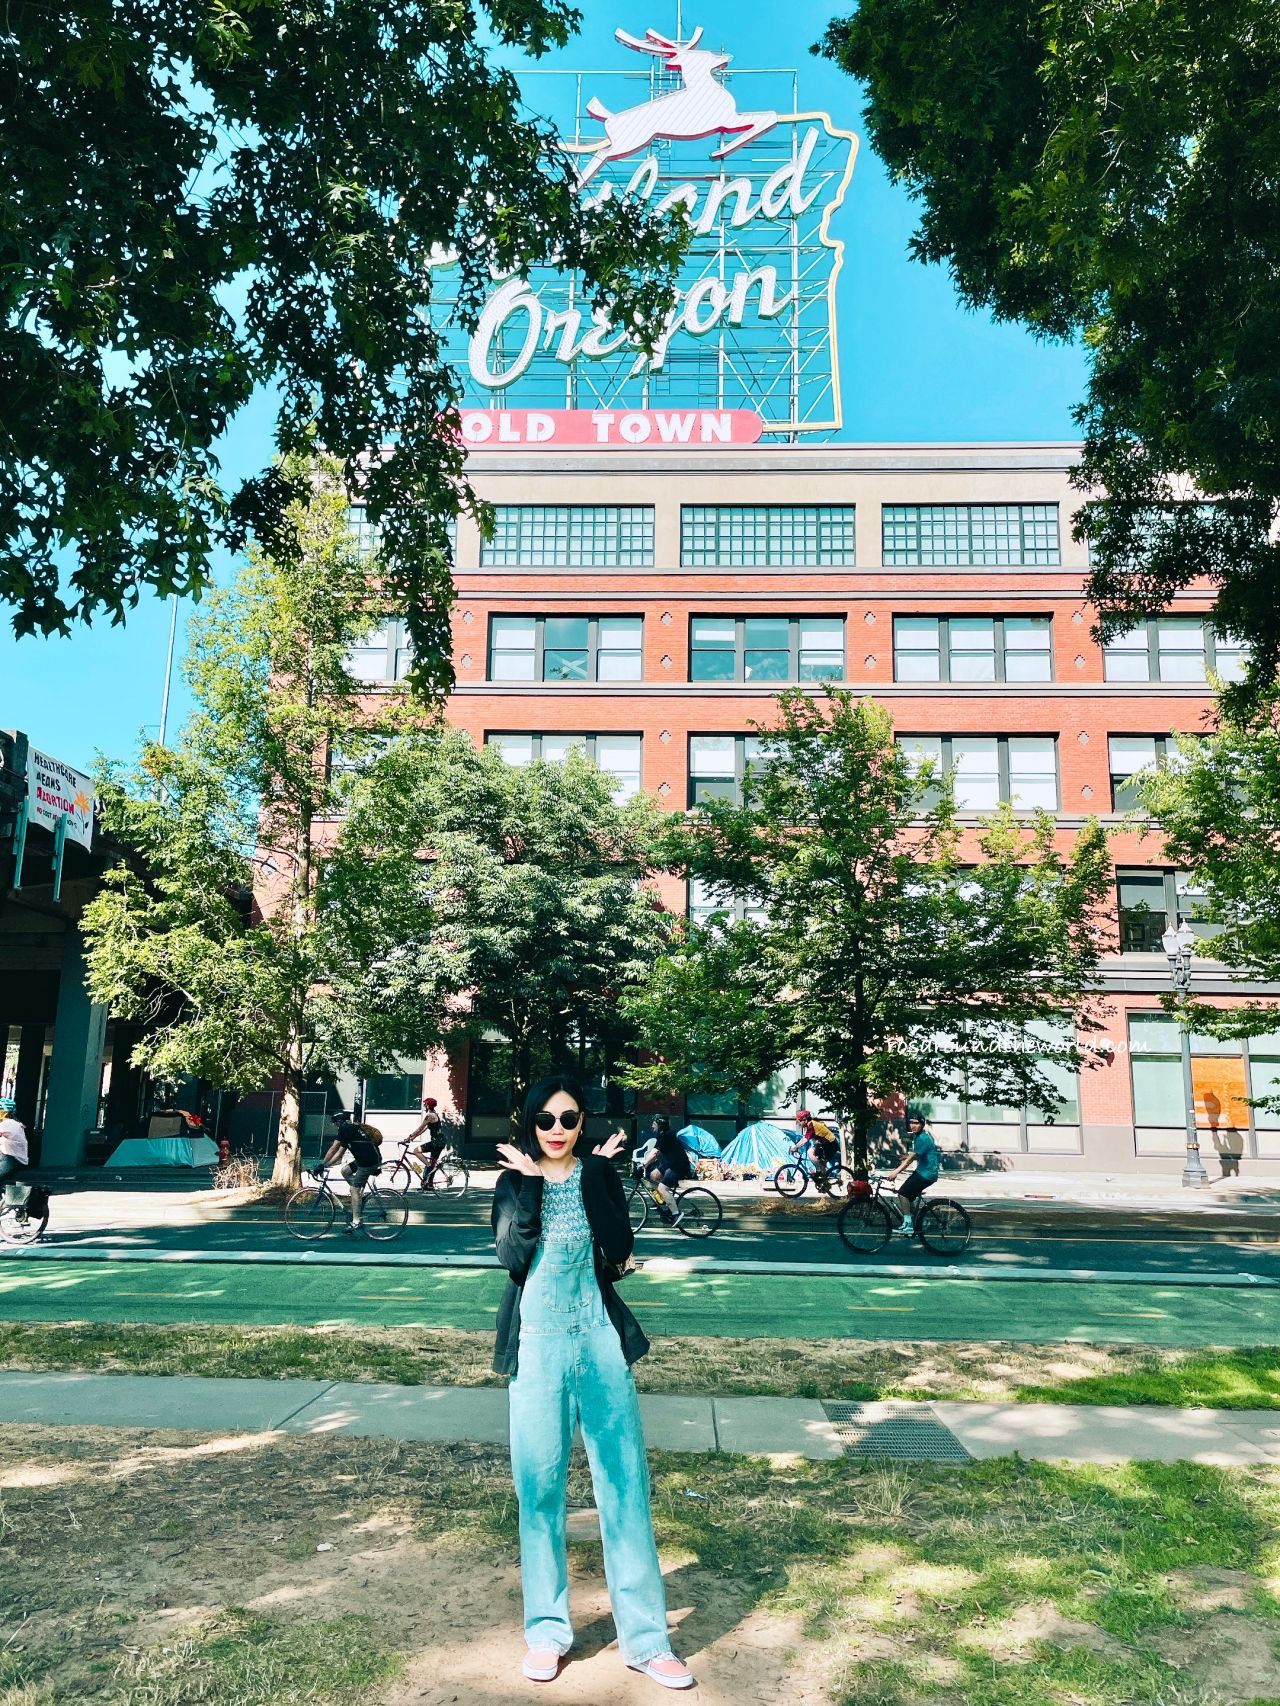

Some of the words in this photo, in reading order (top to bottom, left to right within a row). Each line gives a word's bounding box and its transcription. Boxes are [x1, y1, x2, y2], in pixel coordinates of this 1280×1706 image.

[462, 412, 556, 443] OLD
[592, 413, 733, 443] TOWN
[34, 752, 76, 788] HEALTHCARE
[37, 786, 74, 815] ABORTION
